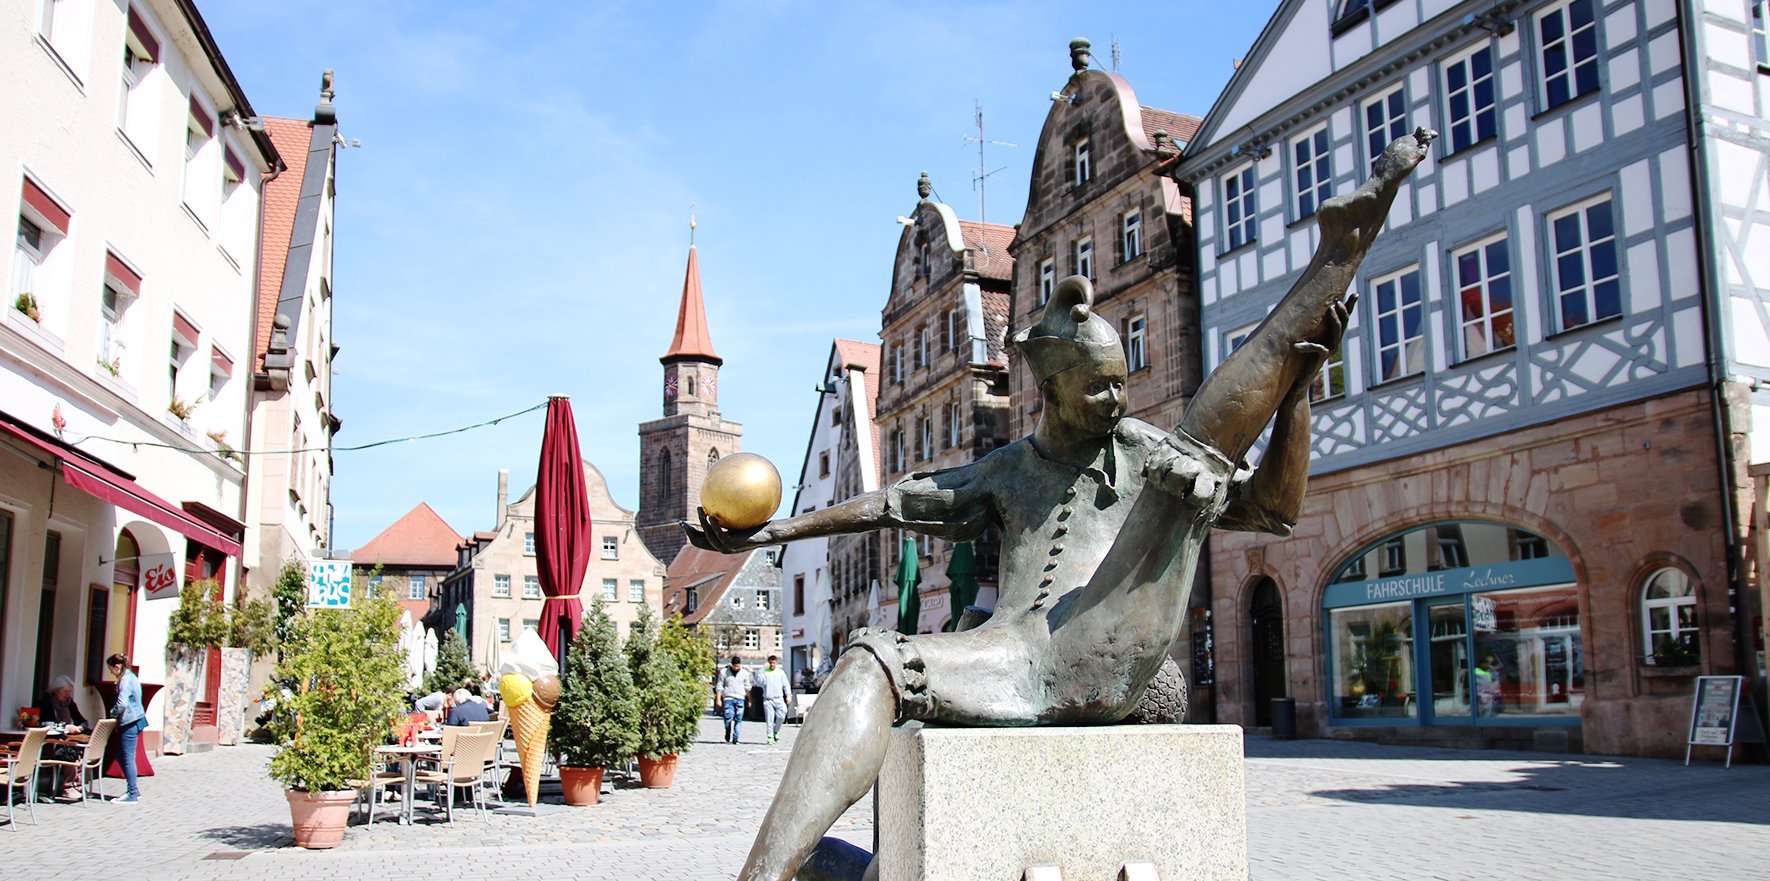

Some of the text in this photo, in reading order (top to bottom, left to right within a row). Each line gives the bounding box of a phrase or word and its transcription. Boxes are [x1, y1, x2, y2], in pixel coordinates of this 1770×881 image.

[145, 564, 175, 591] Eis
[1367, 568, 1516, 600] FAHRSCHULE Lechner
